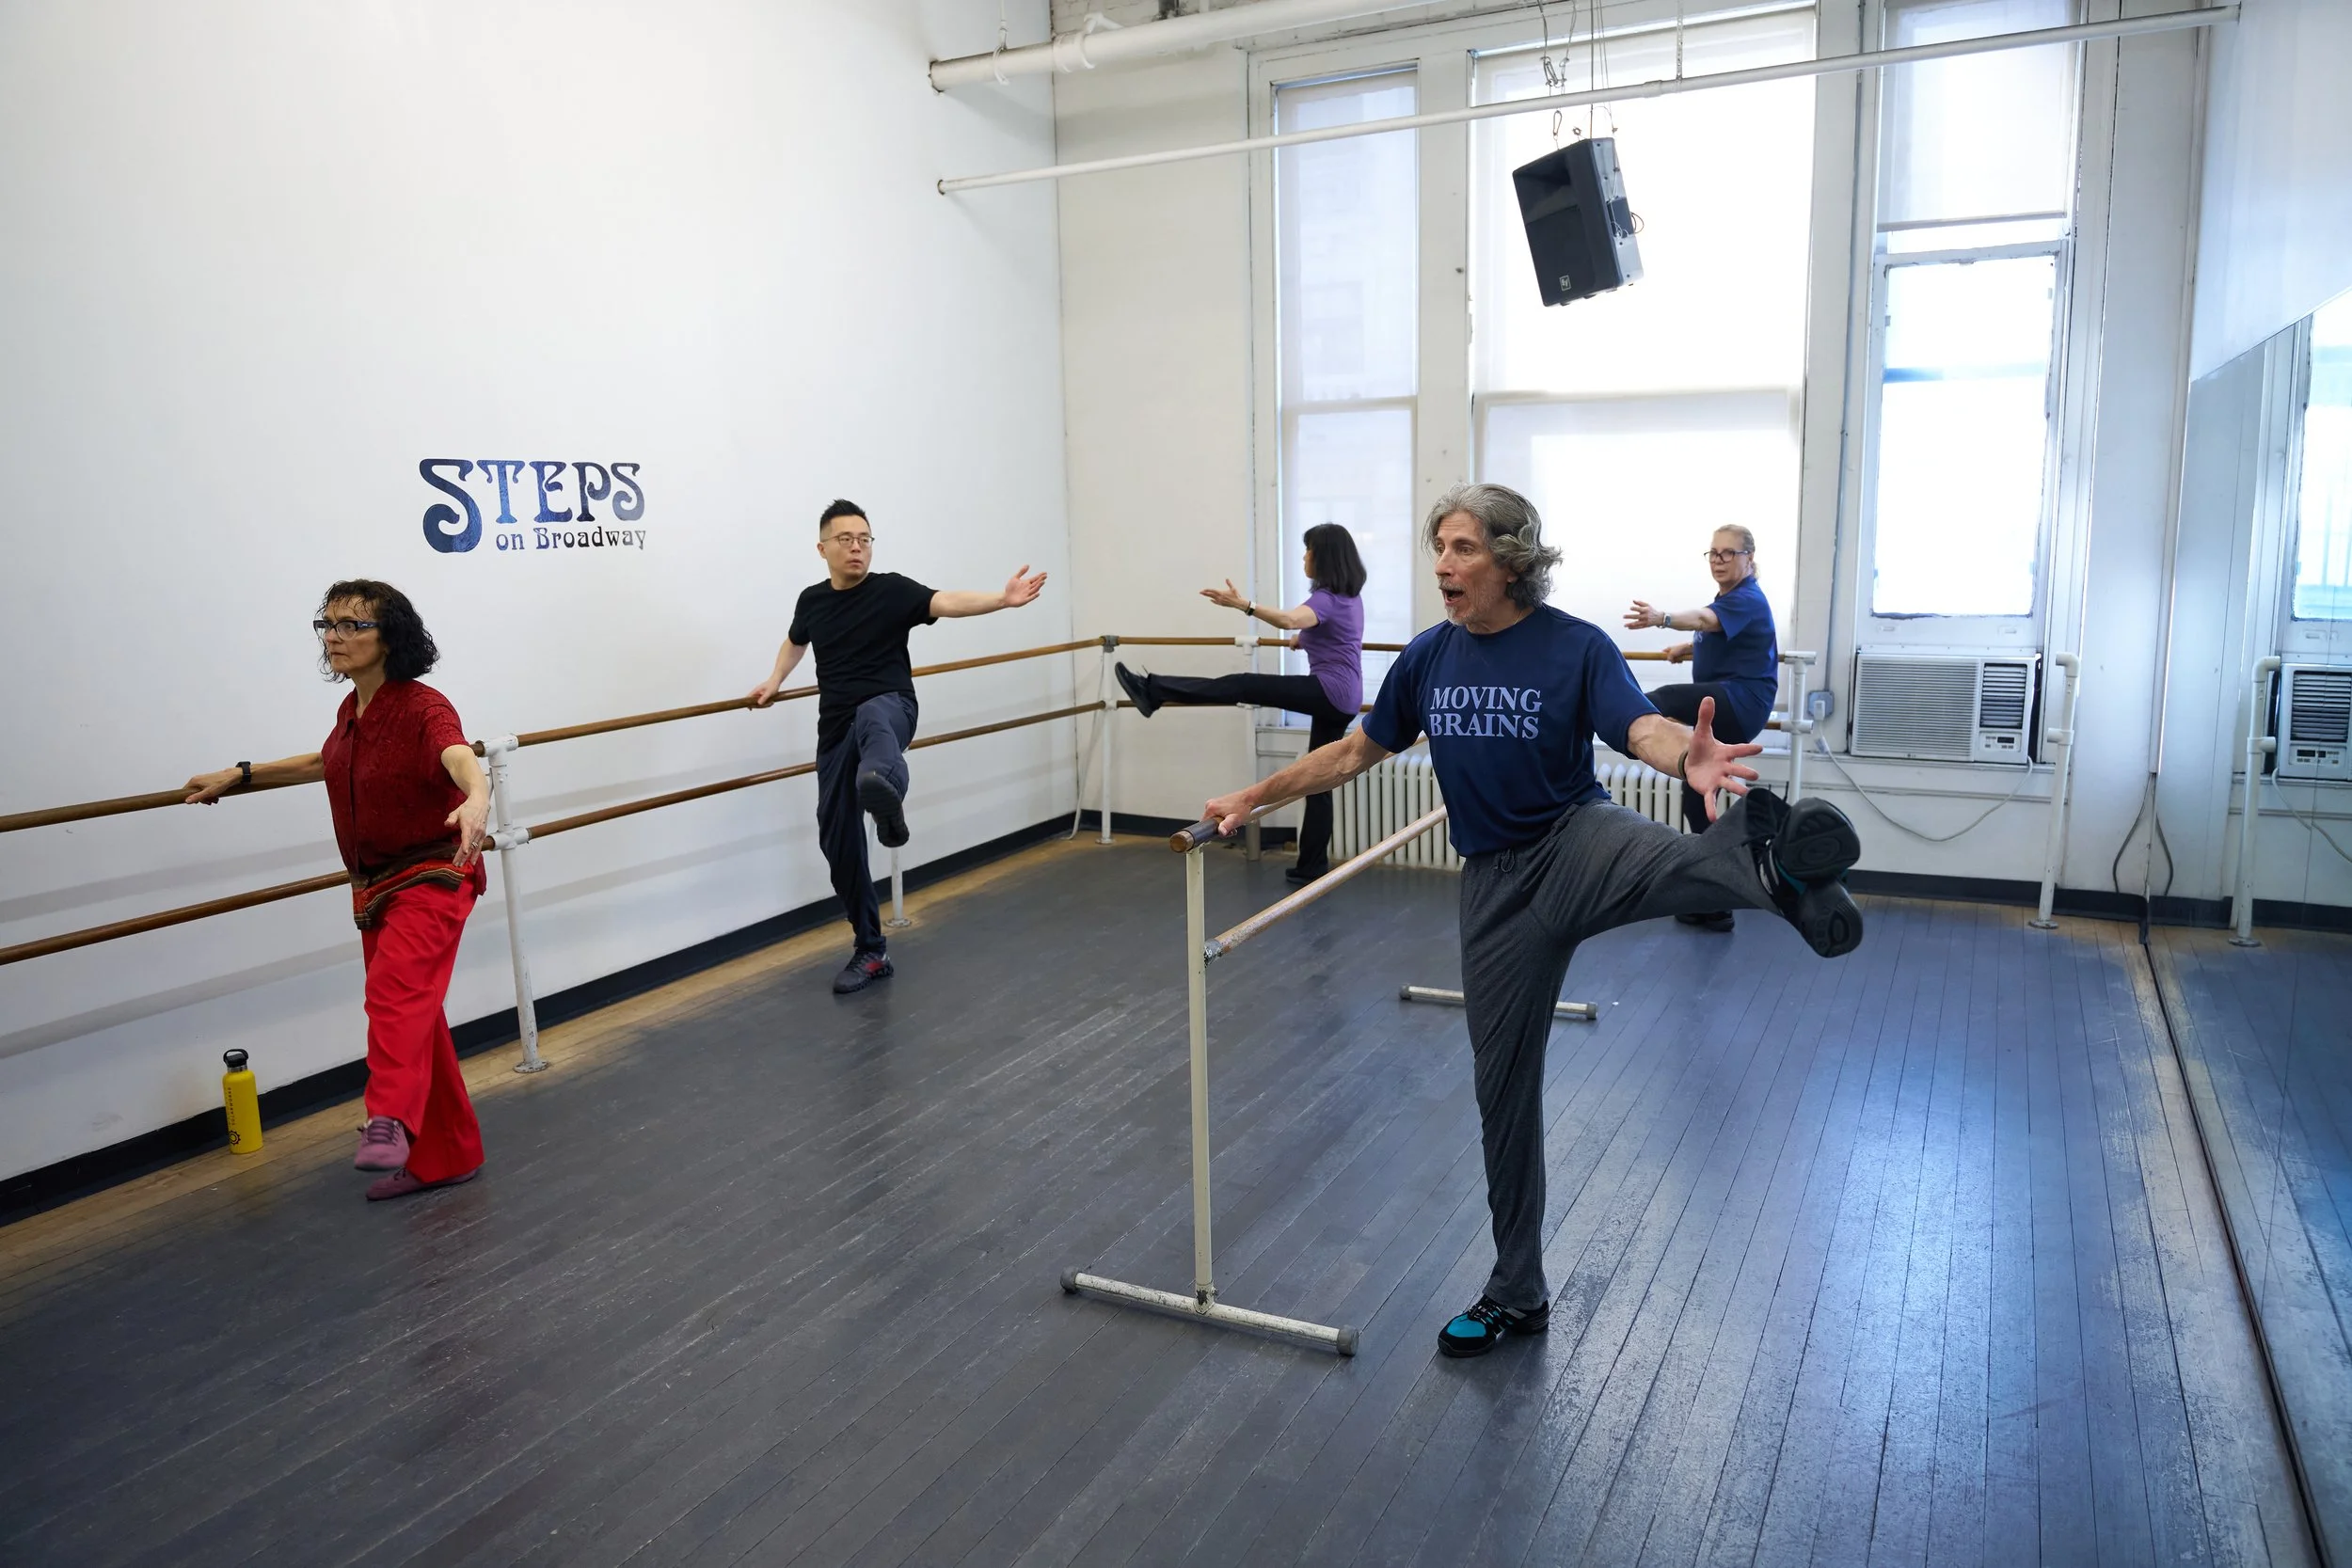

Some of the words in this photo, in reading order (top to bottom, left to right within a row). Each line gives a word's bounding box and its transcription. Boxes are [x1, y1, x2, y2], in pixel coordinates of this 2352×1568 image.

[419, 458, 645, 553] STEPS
[495, 533, 525, 551] on
[532, 526, 646, 550] Broadway
[1430, 686, 1543, 713] MOVING
[1429, 713, 1539, 740] BRAINS
